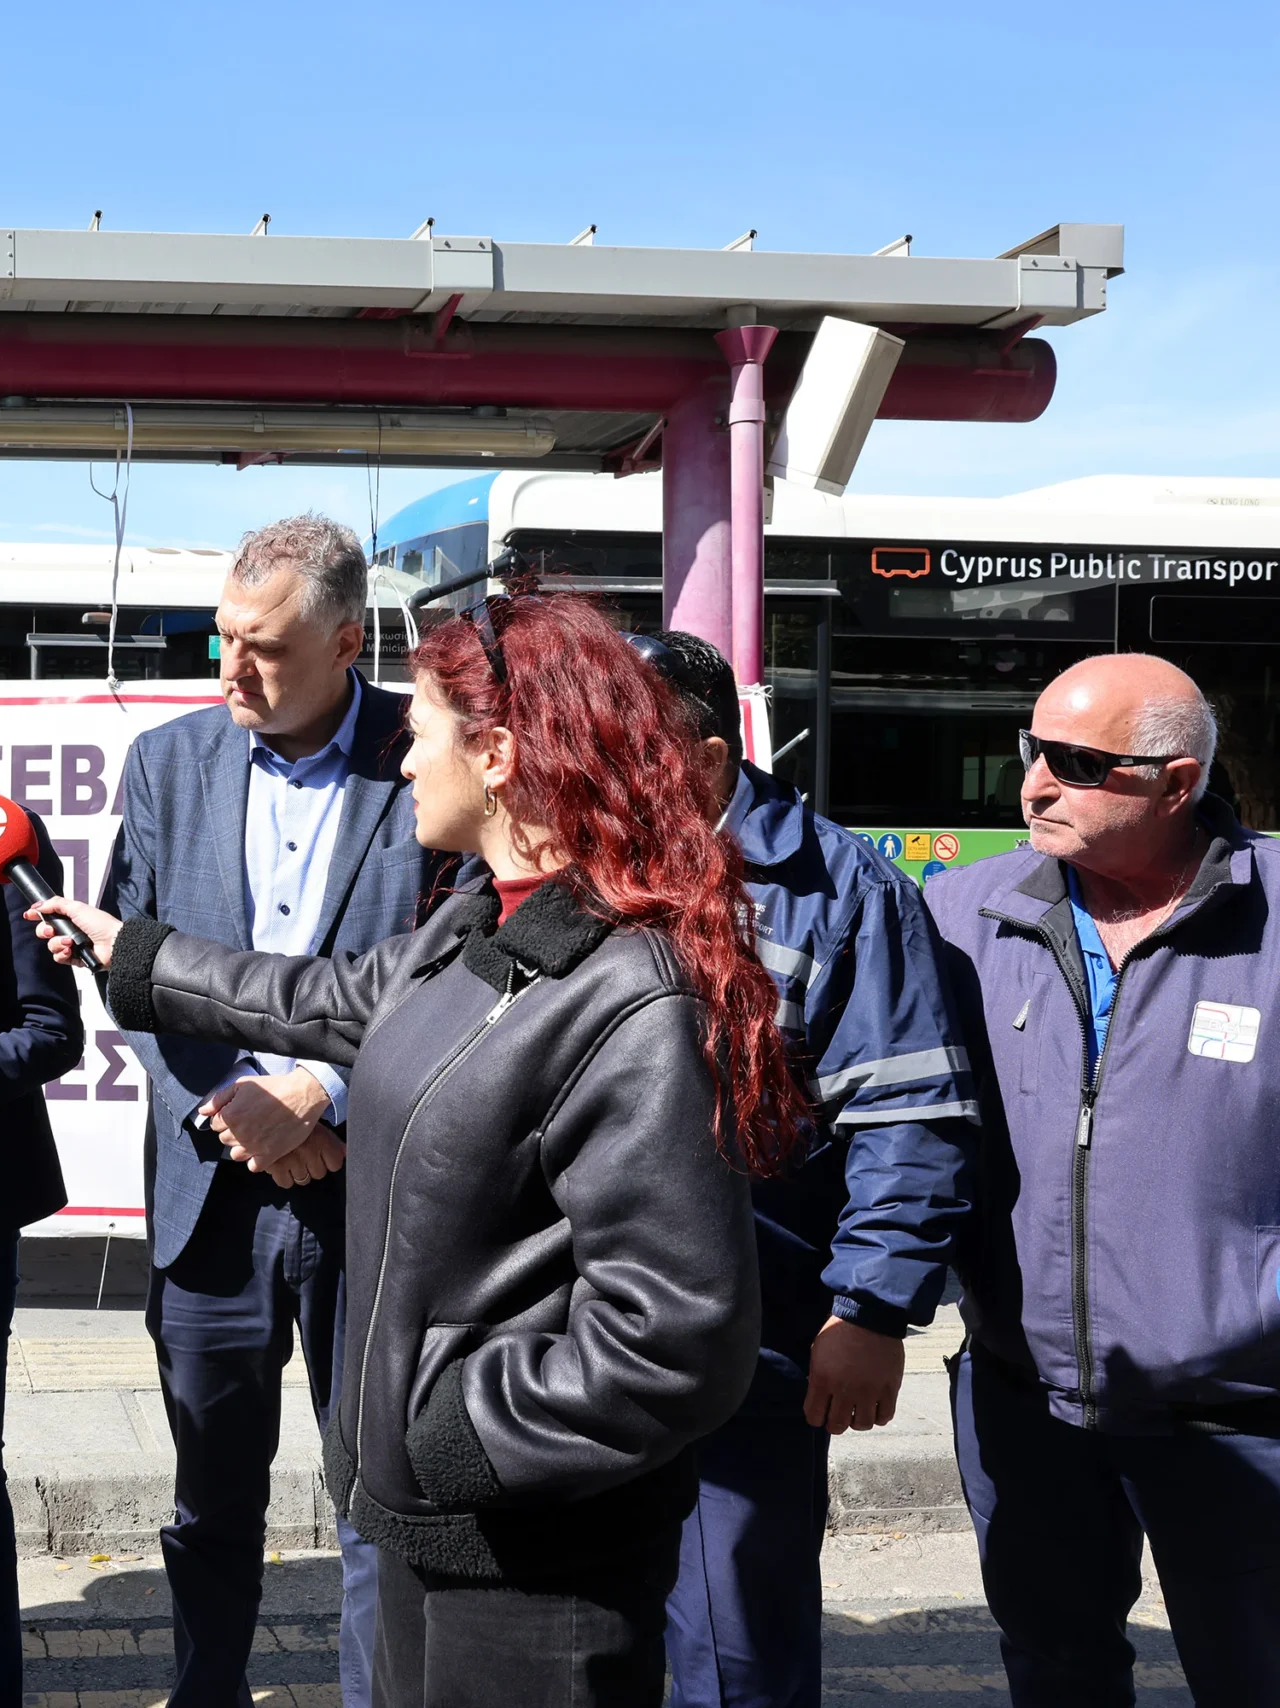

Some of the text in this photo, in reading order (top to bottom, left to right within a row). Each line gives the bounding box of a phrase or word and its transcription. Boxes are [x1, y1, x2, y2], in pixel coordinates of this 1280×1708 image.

[940, 549, 1279, 587] Cyprus Public Transpor
